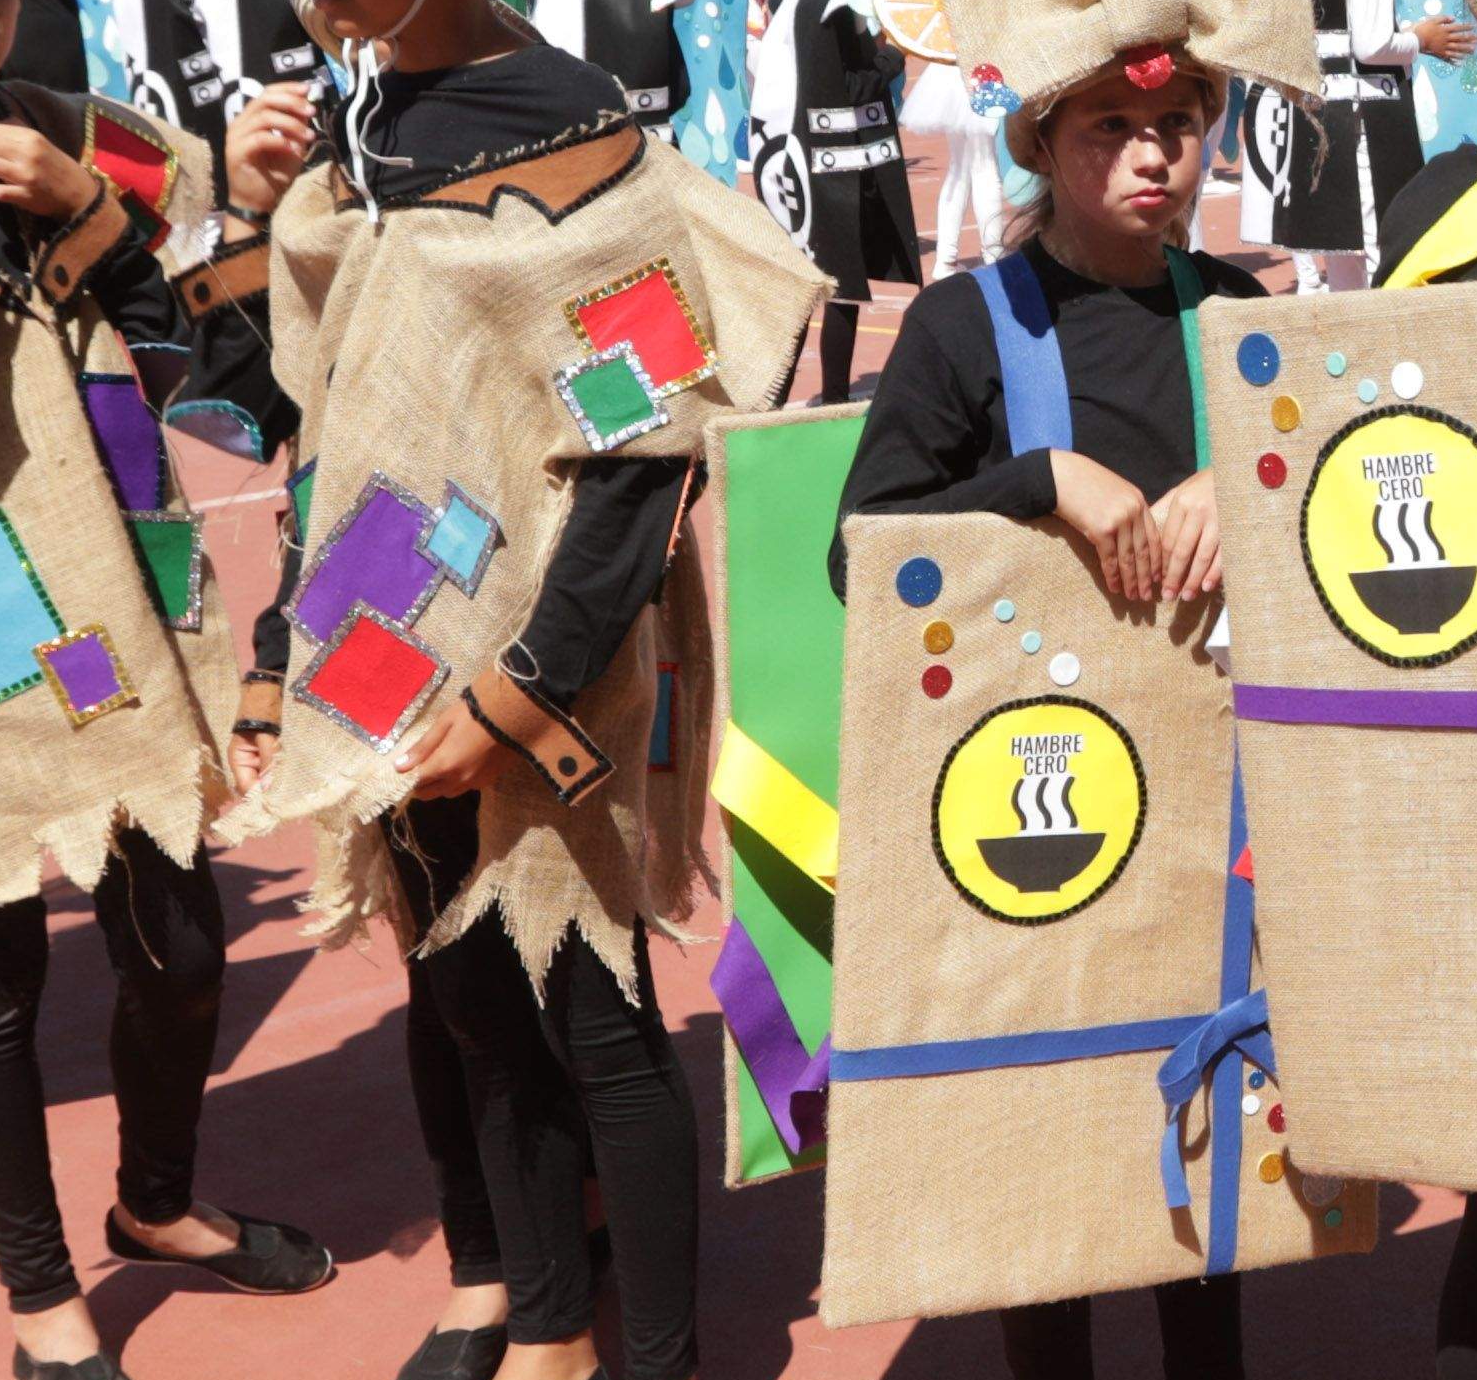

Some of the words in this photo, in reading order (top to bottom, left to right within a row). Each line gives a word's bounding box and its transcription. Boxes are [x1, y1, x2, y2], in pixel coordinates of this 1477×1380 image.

[1361, 452, 1436, 480] HAMBRE
[1378, 476, 1424, 502] CERO
[1010, 734, 1083, 756] HAMBRE
[1023, 754, 1068, 776] CERO
